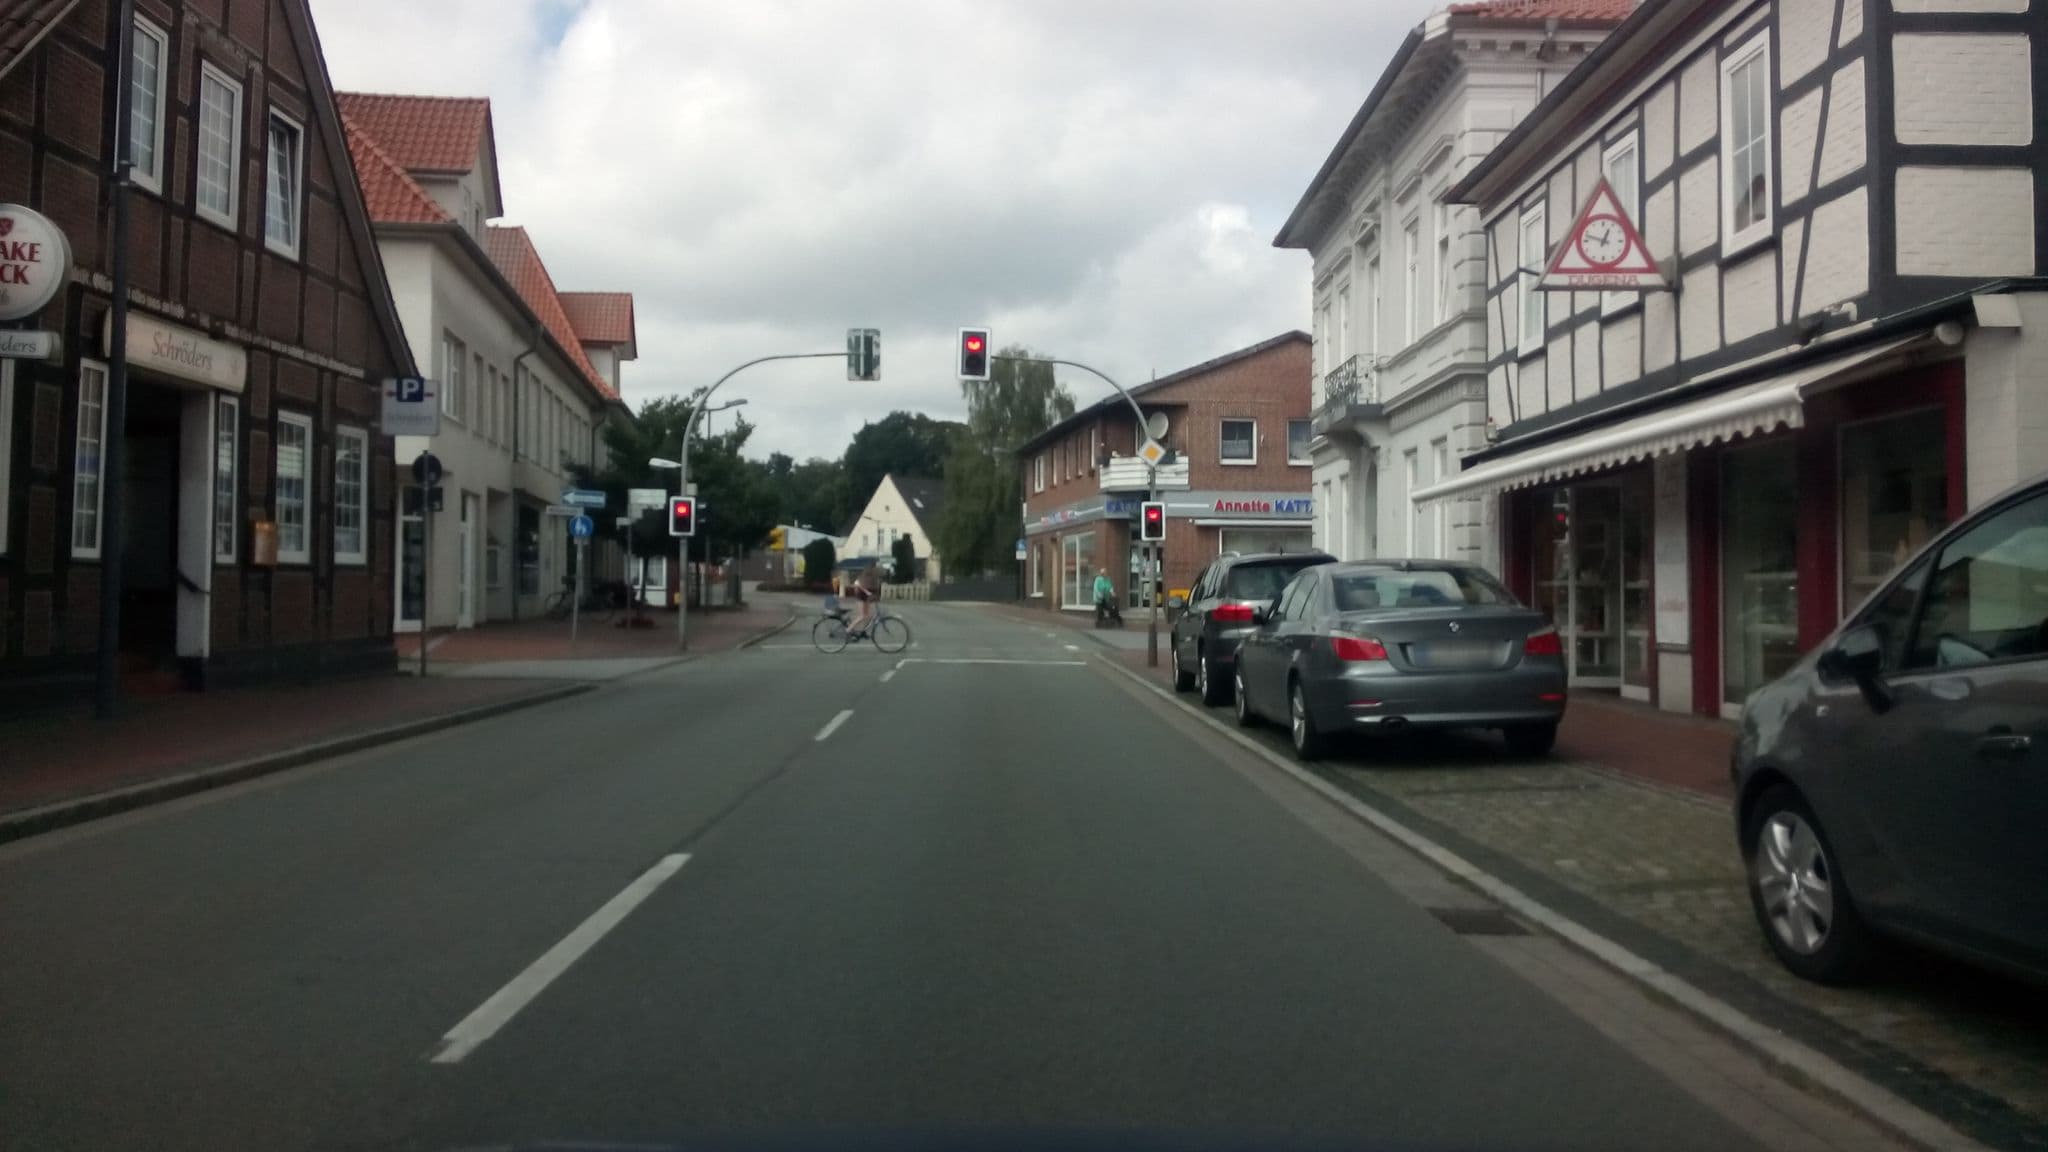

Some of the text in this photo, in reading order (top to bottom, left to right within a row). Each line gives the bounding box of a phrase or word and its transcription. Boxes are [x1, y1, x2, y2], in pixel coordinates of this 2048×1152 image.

[151, 329, 213, 370] Schröders
[402, 378, 419, 400] P
[1215, 498, 1271, 513] Annette
